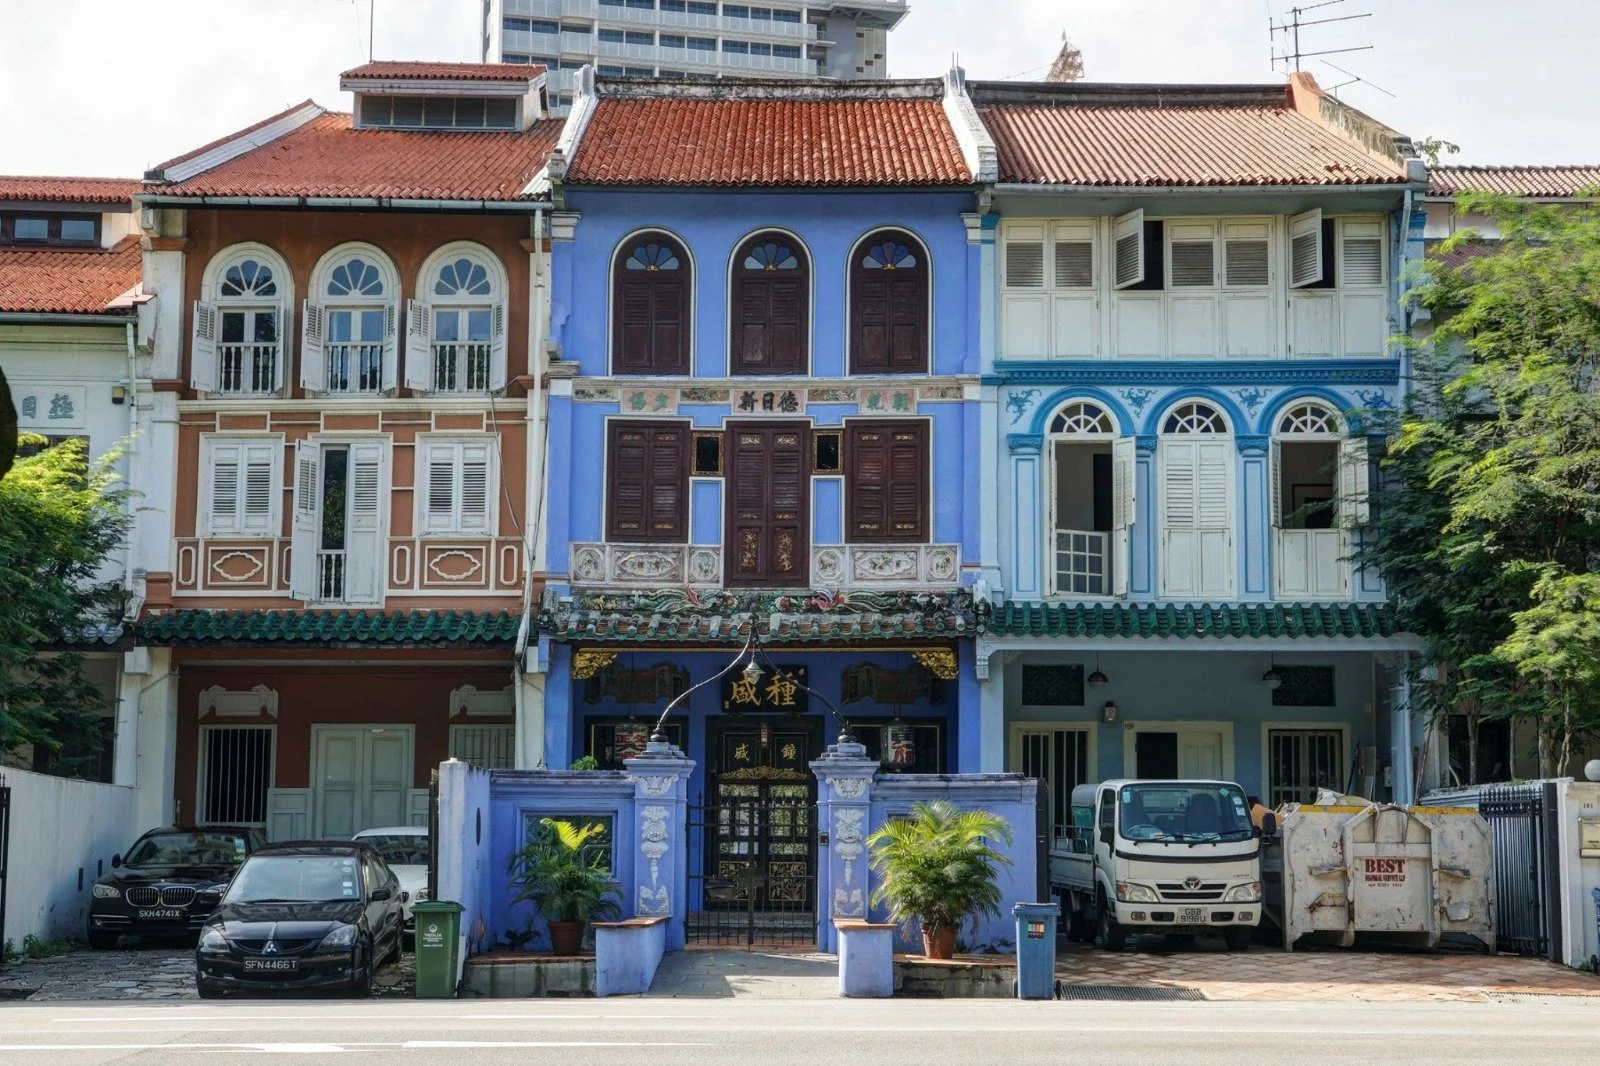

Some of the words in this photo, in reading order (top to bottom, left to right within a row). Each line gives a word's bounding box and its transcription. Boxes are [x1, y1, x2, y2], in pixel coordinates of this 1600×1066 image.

[1364, 859, 1406, 874] BEST
[138, 910, 180, 919] SKH4741X
[245, 959, 297, 970] SFN4466T
